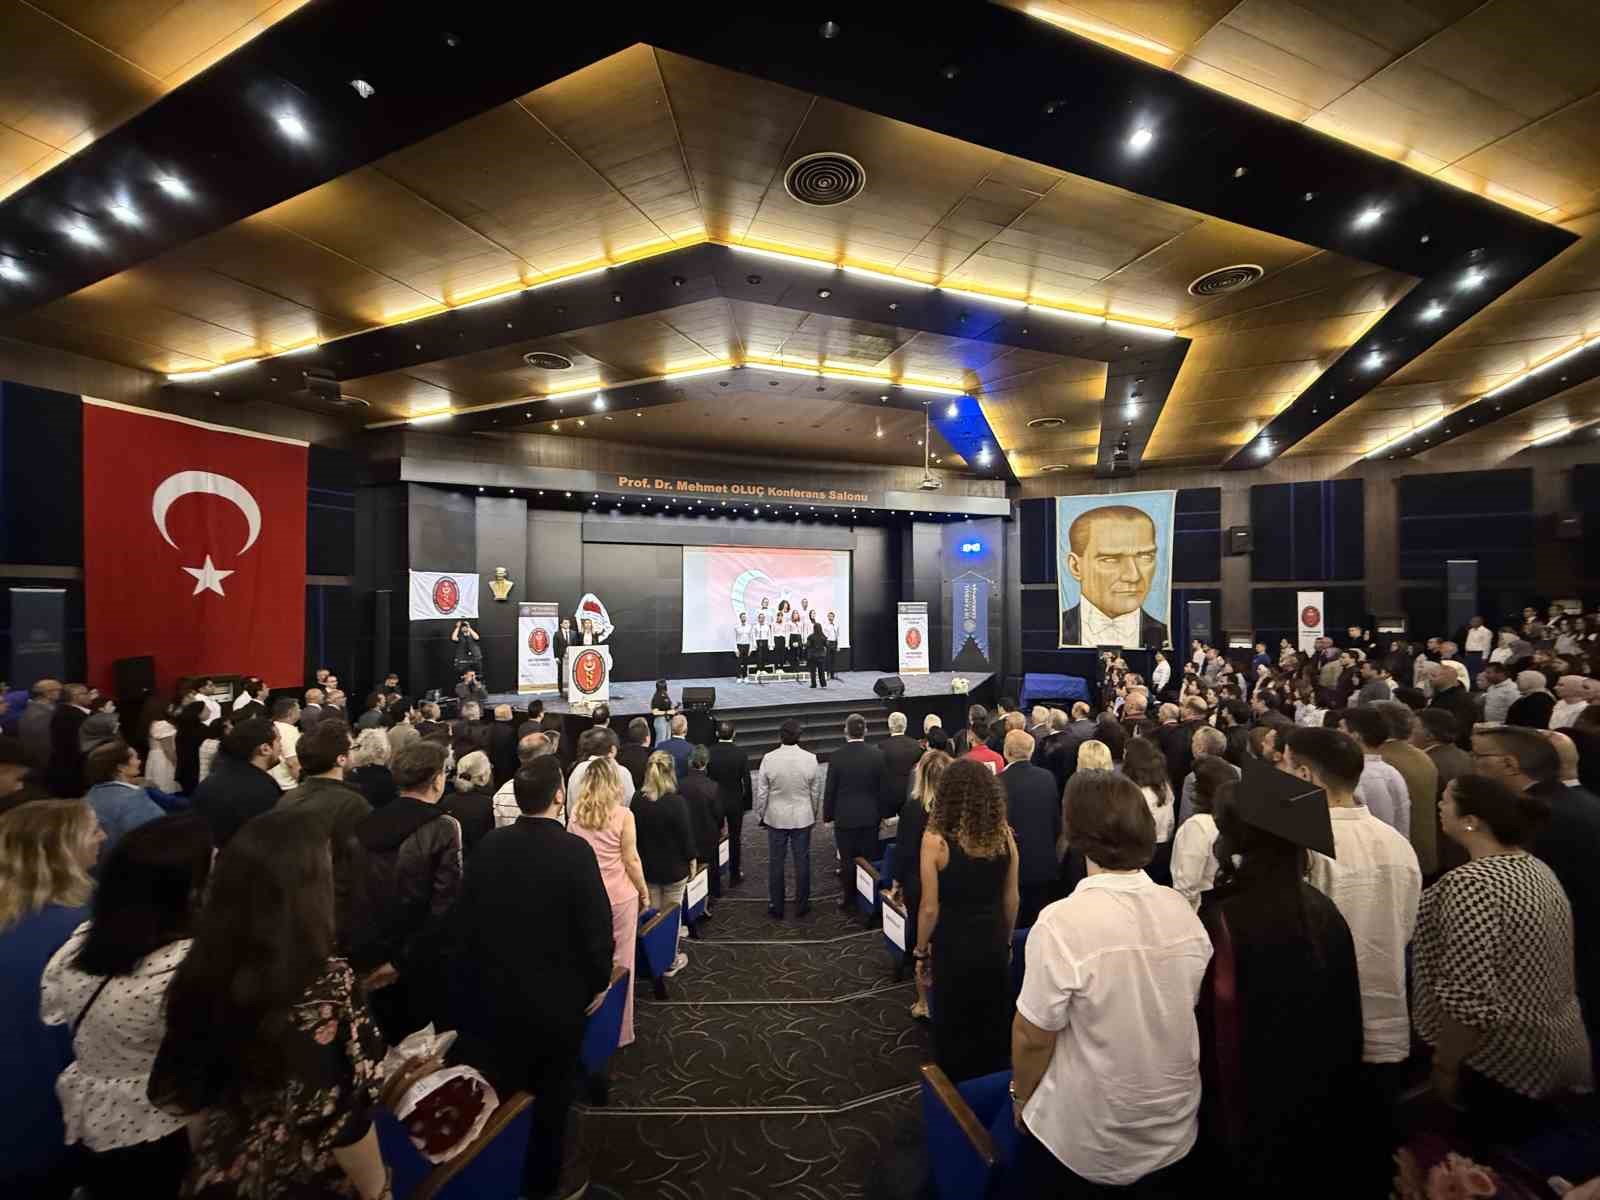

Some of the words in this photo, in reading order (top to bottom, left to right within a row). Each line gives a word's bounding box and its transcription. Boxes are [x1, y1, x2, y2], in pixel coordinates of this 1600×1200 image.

[618, 476, 651, 489] Prof.
[655, 479, 673, 490] Dr.
[676, 480, 729, 494] Mehmet
[731, 484, 765, 497] OLUÇ
[767, 487, 826, 500] Konferans
[829, 490, 869, 502] Salonu
